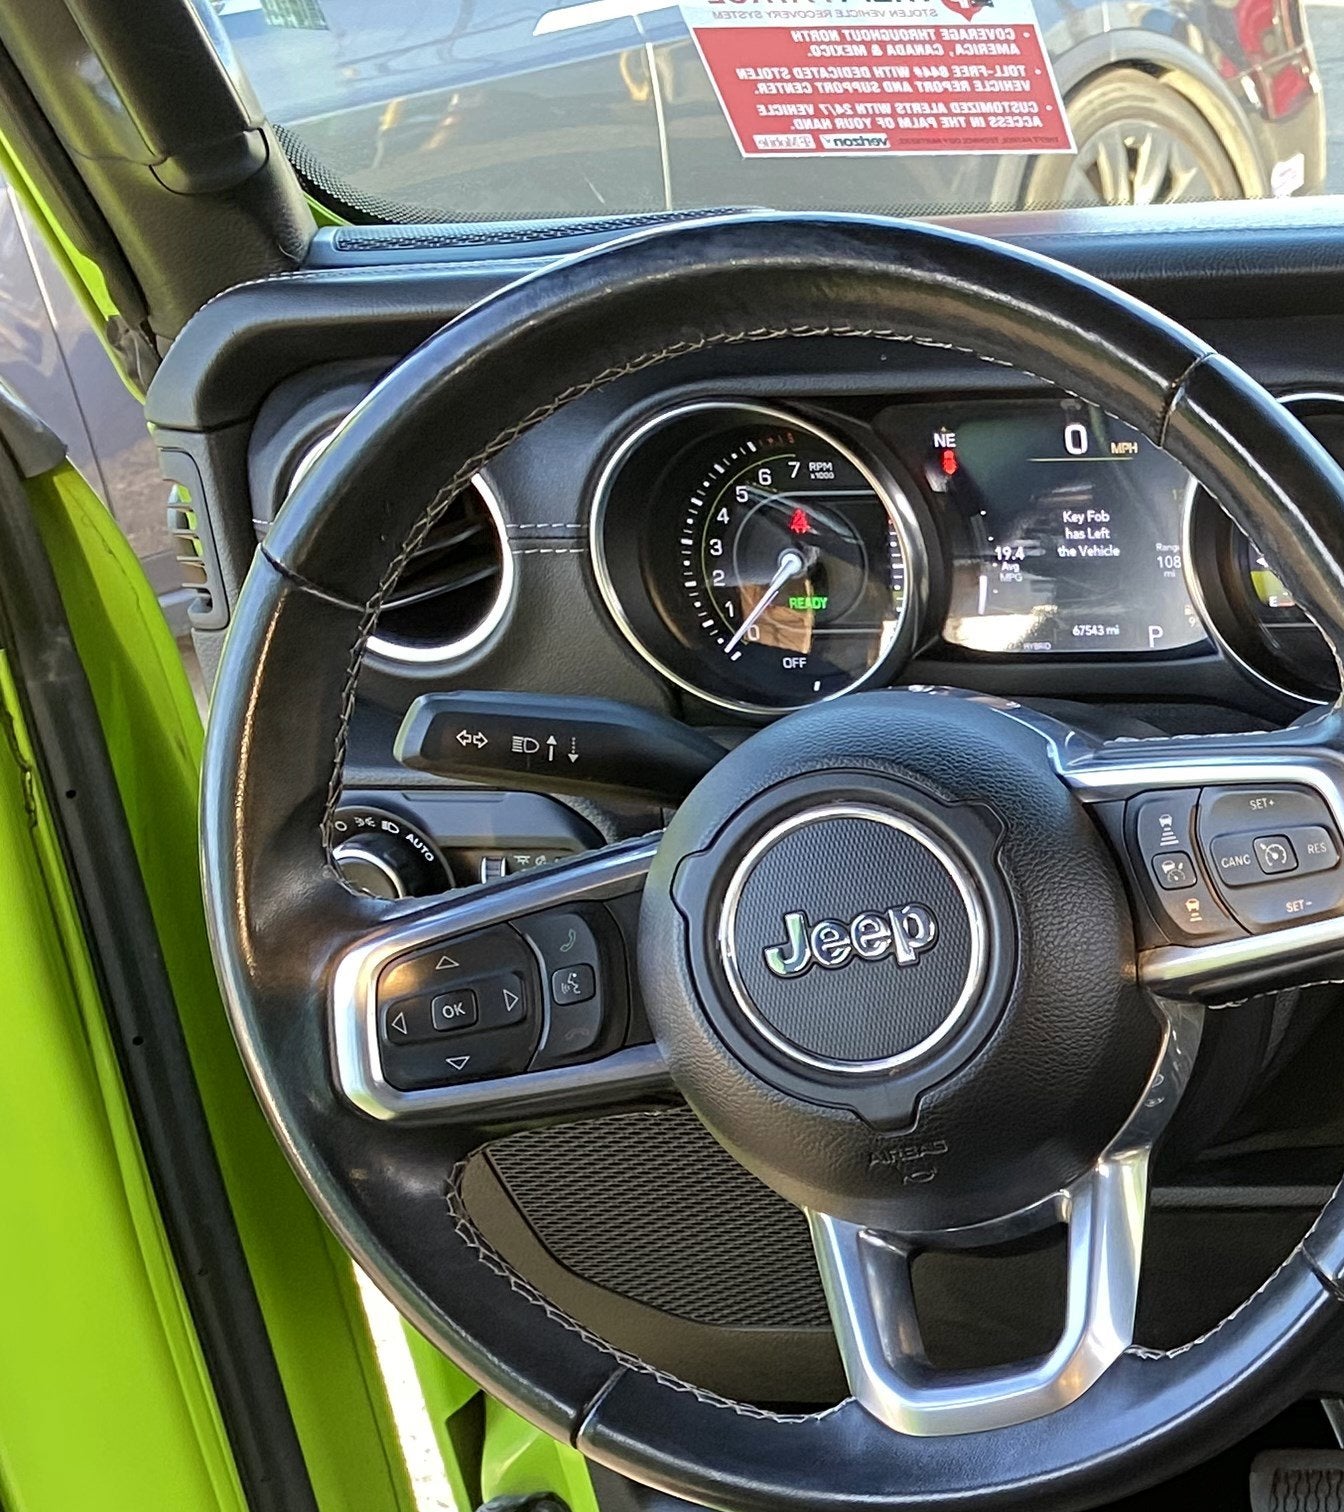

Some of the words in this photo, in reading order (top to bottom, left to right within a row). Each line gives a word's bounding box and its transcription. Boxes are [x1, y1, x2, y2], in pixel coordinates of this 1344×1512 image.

[933, 433, 957, 448] NE
[1064, 423, 1088, 455] 0
[1110, 442, 1139, 455] MPH
[788, 461, 800, 478] 7
[809, 462, 833, 471] RPM
[758, 468, 772, 485] 6
[736, 486, 749, 502] 5
[716, 507, 730, 525] 4
[1062, 510, 1085, 525] Key
[1086, 510, 1111, 523] Fob
[1065, 527, 1086, 540] has
[1087, 527, 1111, 540] Left
[709, 539, 723, 556] 3
[994, 546, 1026, 561] 19.4
[1057, 545, 1077, 558] the
[1078, 545, 1121, 558] Vehicle
[1001, 562, 1021, 574] Avg
[1156, 555, 1182, 569] 108
[712, 570, 726, 587] 2
[1000, 573, 1024, 583] MPG
[1163, 570, 1177, 578] mi
[724, 601, 735, 618] 1
[788, 596, 828, 610] READY
[747, 624, 761, 641] 0
[1072, 624, 1105, 637] 67543
[1106, 624, 1121, 637] mi
[1148, 625, 1164, 649] P
[782, 656, 807, 669] OFF
[405, 833, 436, 863] AUTO
[1307, 842, 1328, 855] RES
[1221, 854, 1252, 868] CANC
[763, 902, 939, 979] Jeep
[442, 1002, 466, 1019] OK
